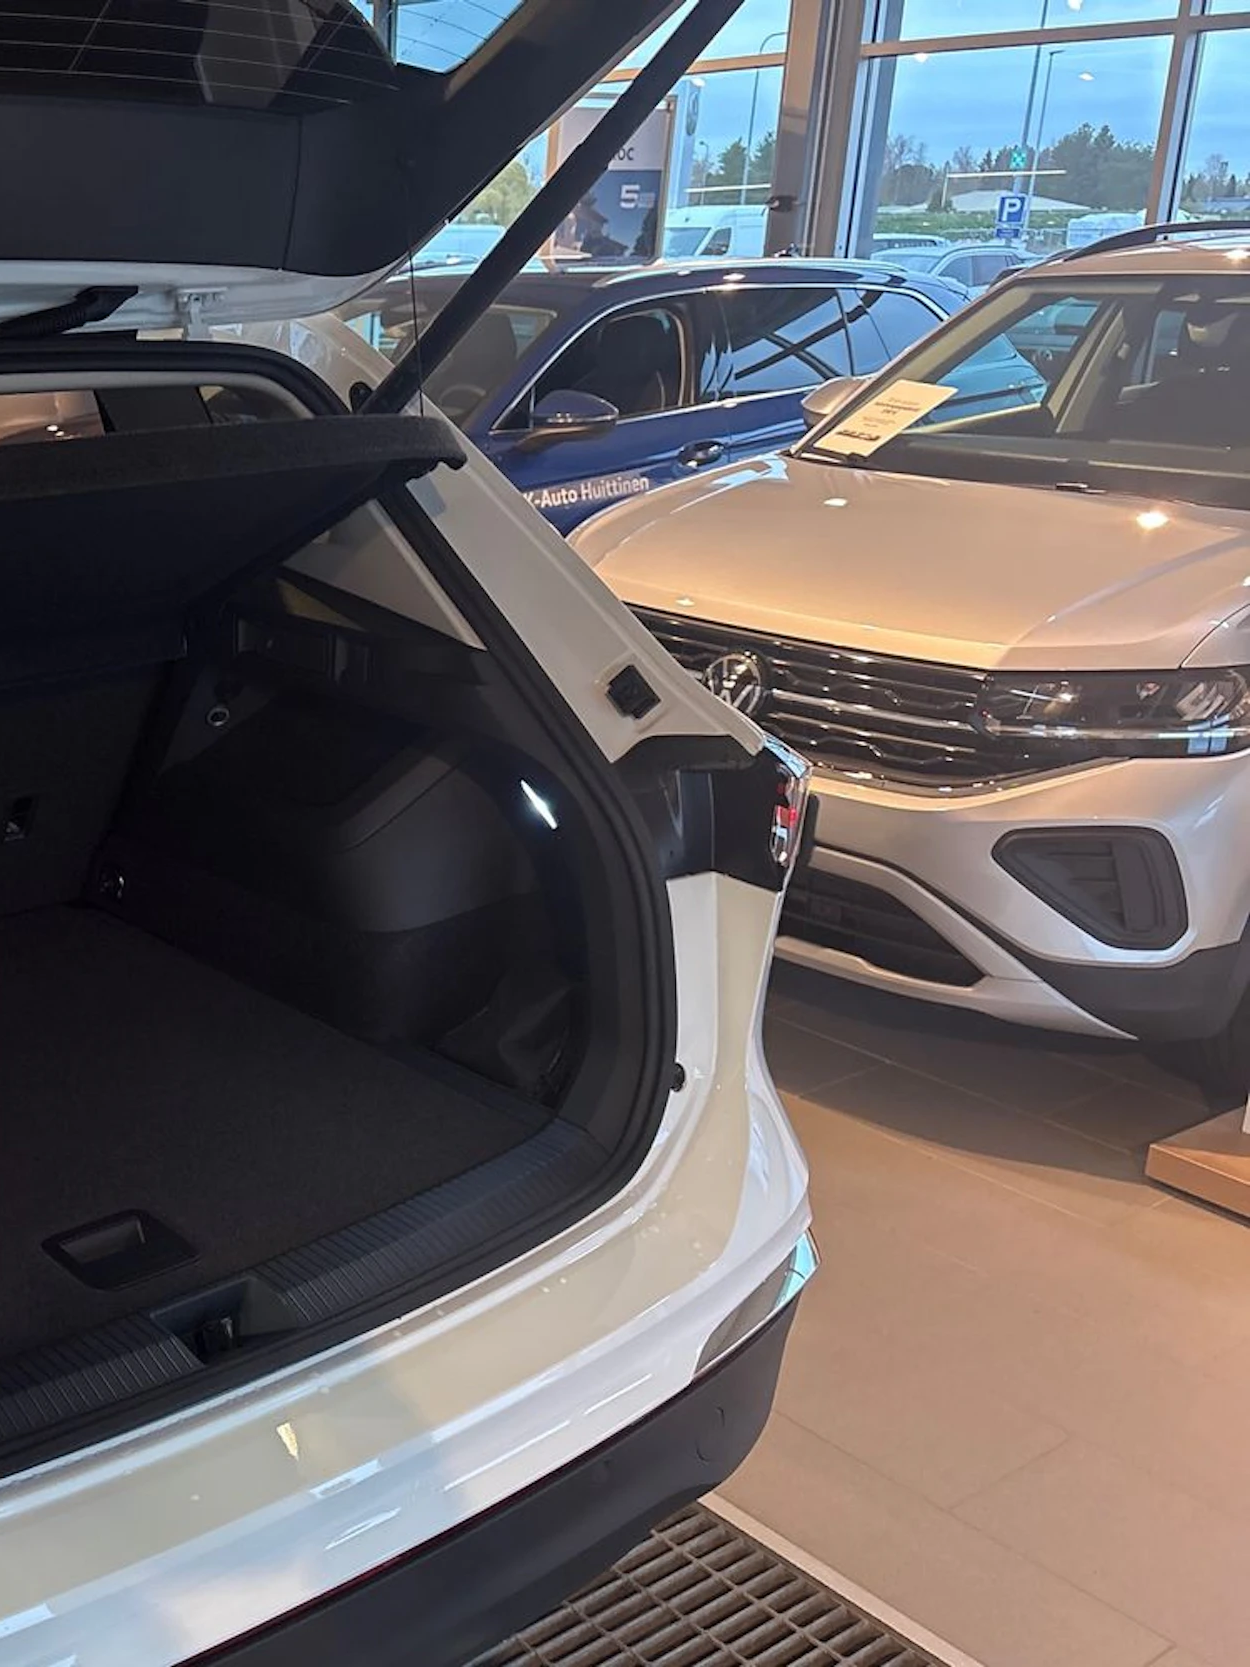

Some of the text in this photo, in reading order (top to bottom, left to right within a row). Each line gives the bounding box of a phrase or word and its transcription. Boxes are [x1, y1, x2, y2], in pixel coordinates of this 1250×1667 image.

[621, 184, 640, 209] 5
[1001, 198, 1021, 221] P
[580, 476, 649, 501] Huittinen
